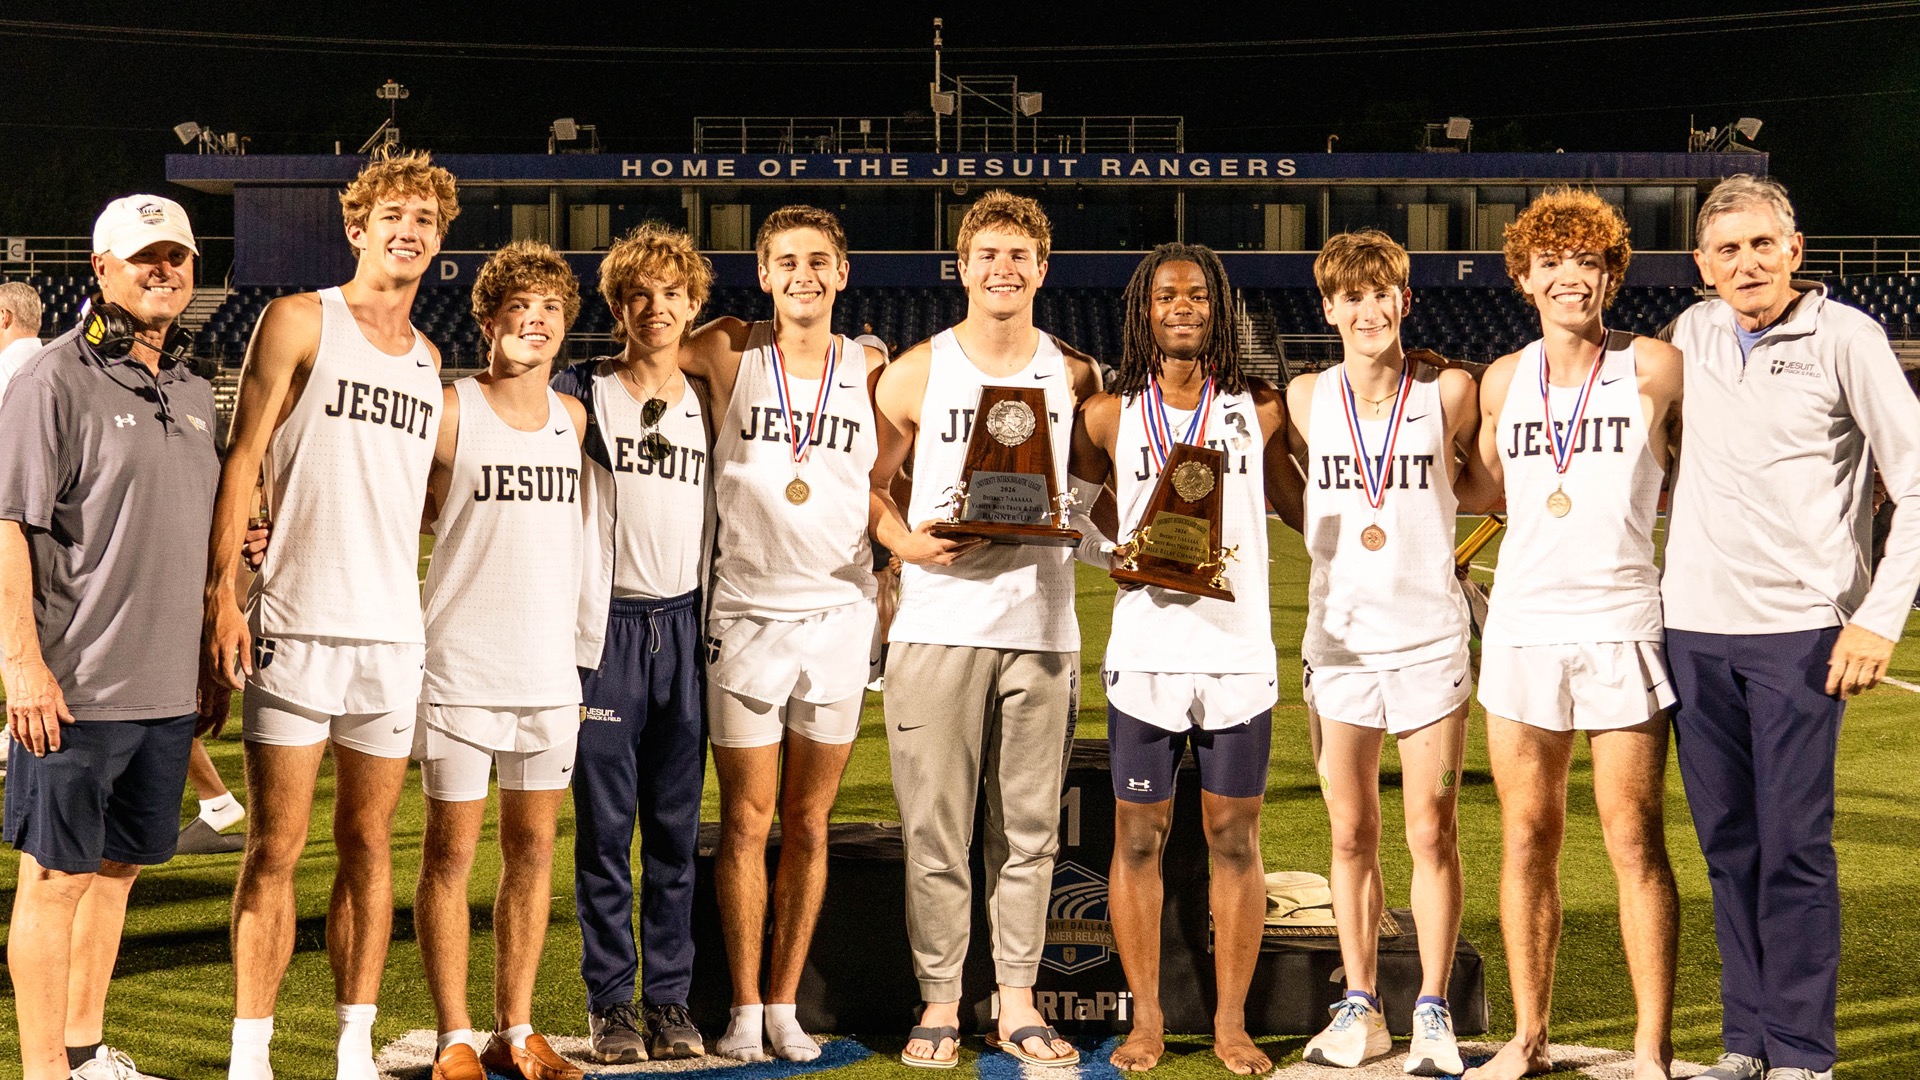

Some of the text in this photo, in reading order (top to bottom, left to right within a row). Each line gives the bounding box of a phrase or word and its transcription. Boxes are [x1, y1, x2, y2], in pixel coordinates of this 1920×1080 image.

[621, 158, 1297, 177] HOME OF THE JESUIT RANGERS
[11, 243, 22, 258] C
[440, 260, 459, 280] D
[940, 260, 957, 280] E
[1458, 260, 1474, 280] F
[1785, 361, 1815, 371] JESUIT
[325, 379, 434, 440] JESUIT
[615, 436, 706, 486] ESUIT
[474, 465, 580, 504] JESUIT
[982, 512, 1032, 522] RUNNER-UP
[587, 708, 615, 716] JESUIT
[1060, 786, 1081, 847] 1
[1070, 921, 1111, 932] DALLAS
[1075, 932, 1112, 944] RELAYS
